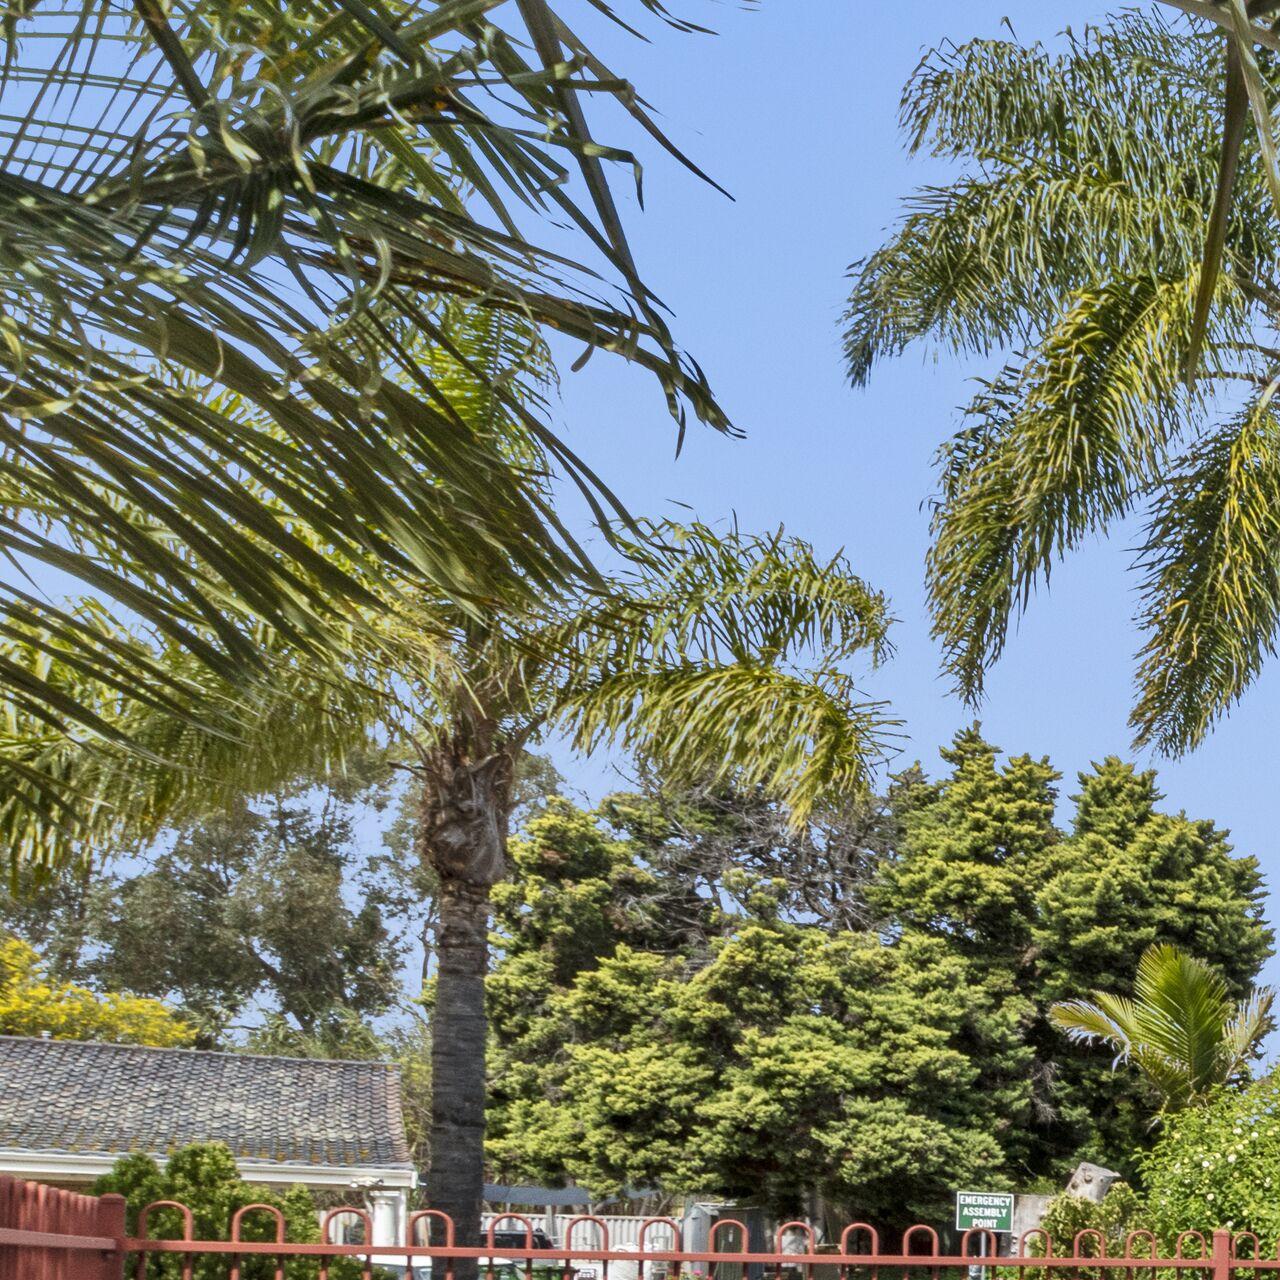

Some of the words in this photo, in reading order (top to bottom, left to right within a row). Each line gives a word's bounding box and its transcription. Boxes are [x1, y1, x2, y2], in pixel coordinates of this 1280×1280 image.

[960, 1195, 1010, 1206] EMERGENCY
[963, 1207, 1007, 1217] ASSEMBLY
[972, 1218, 998, 1229] POINT
